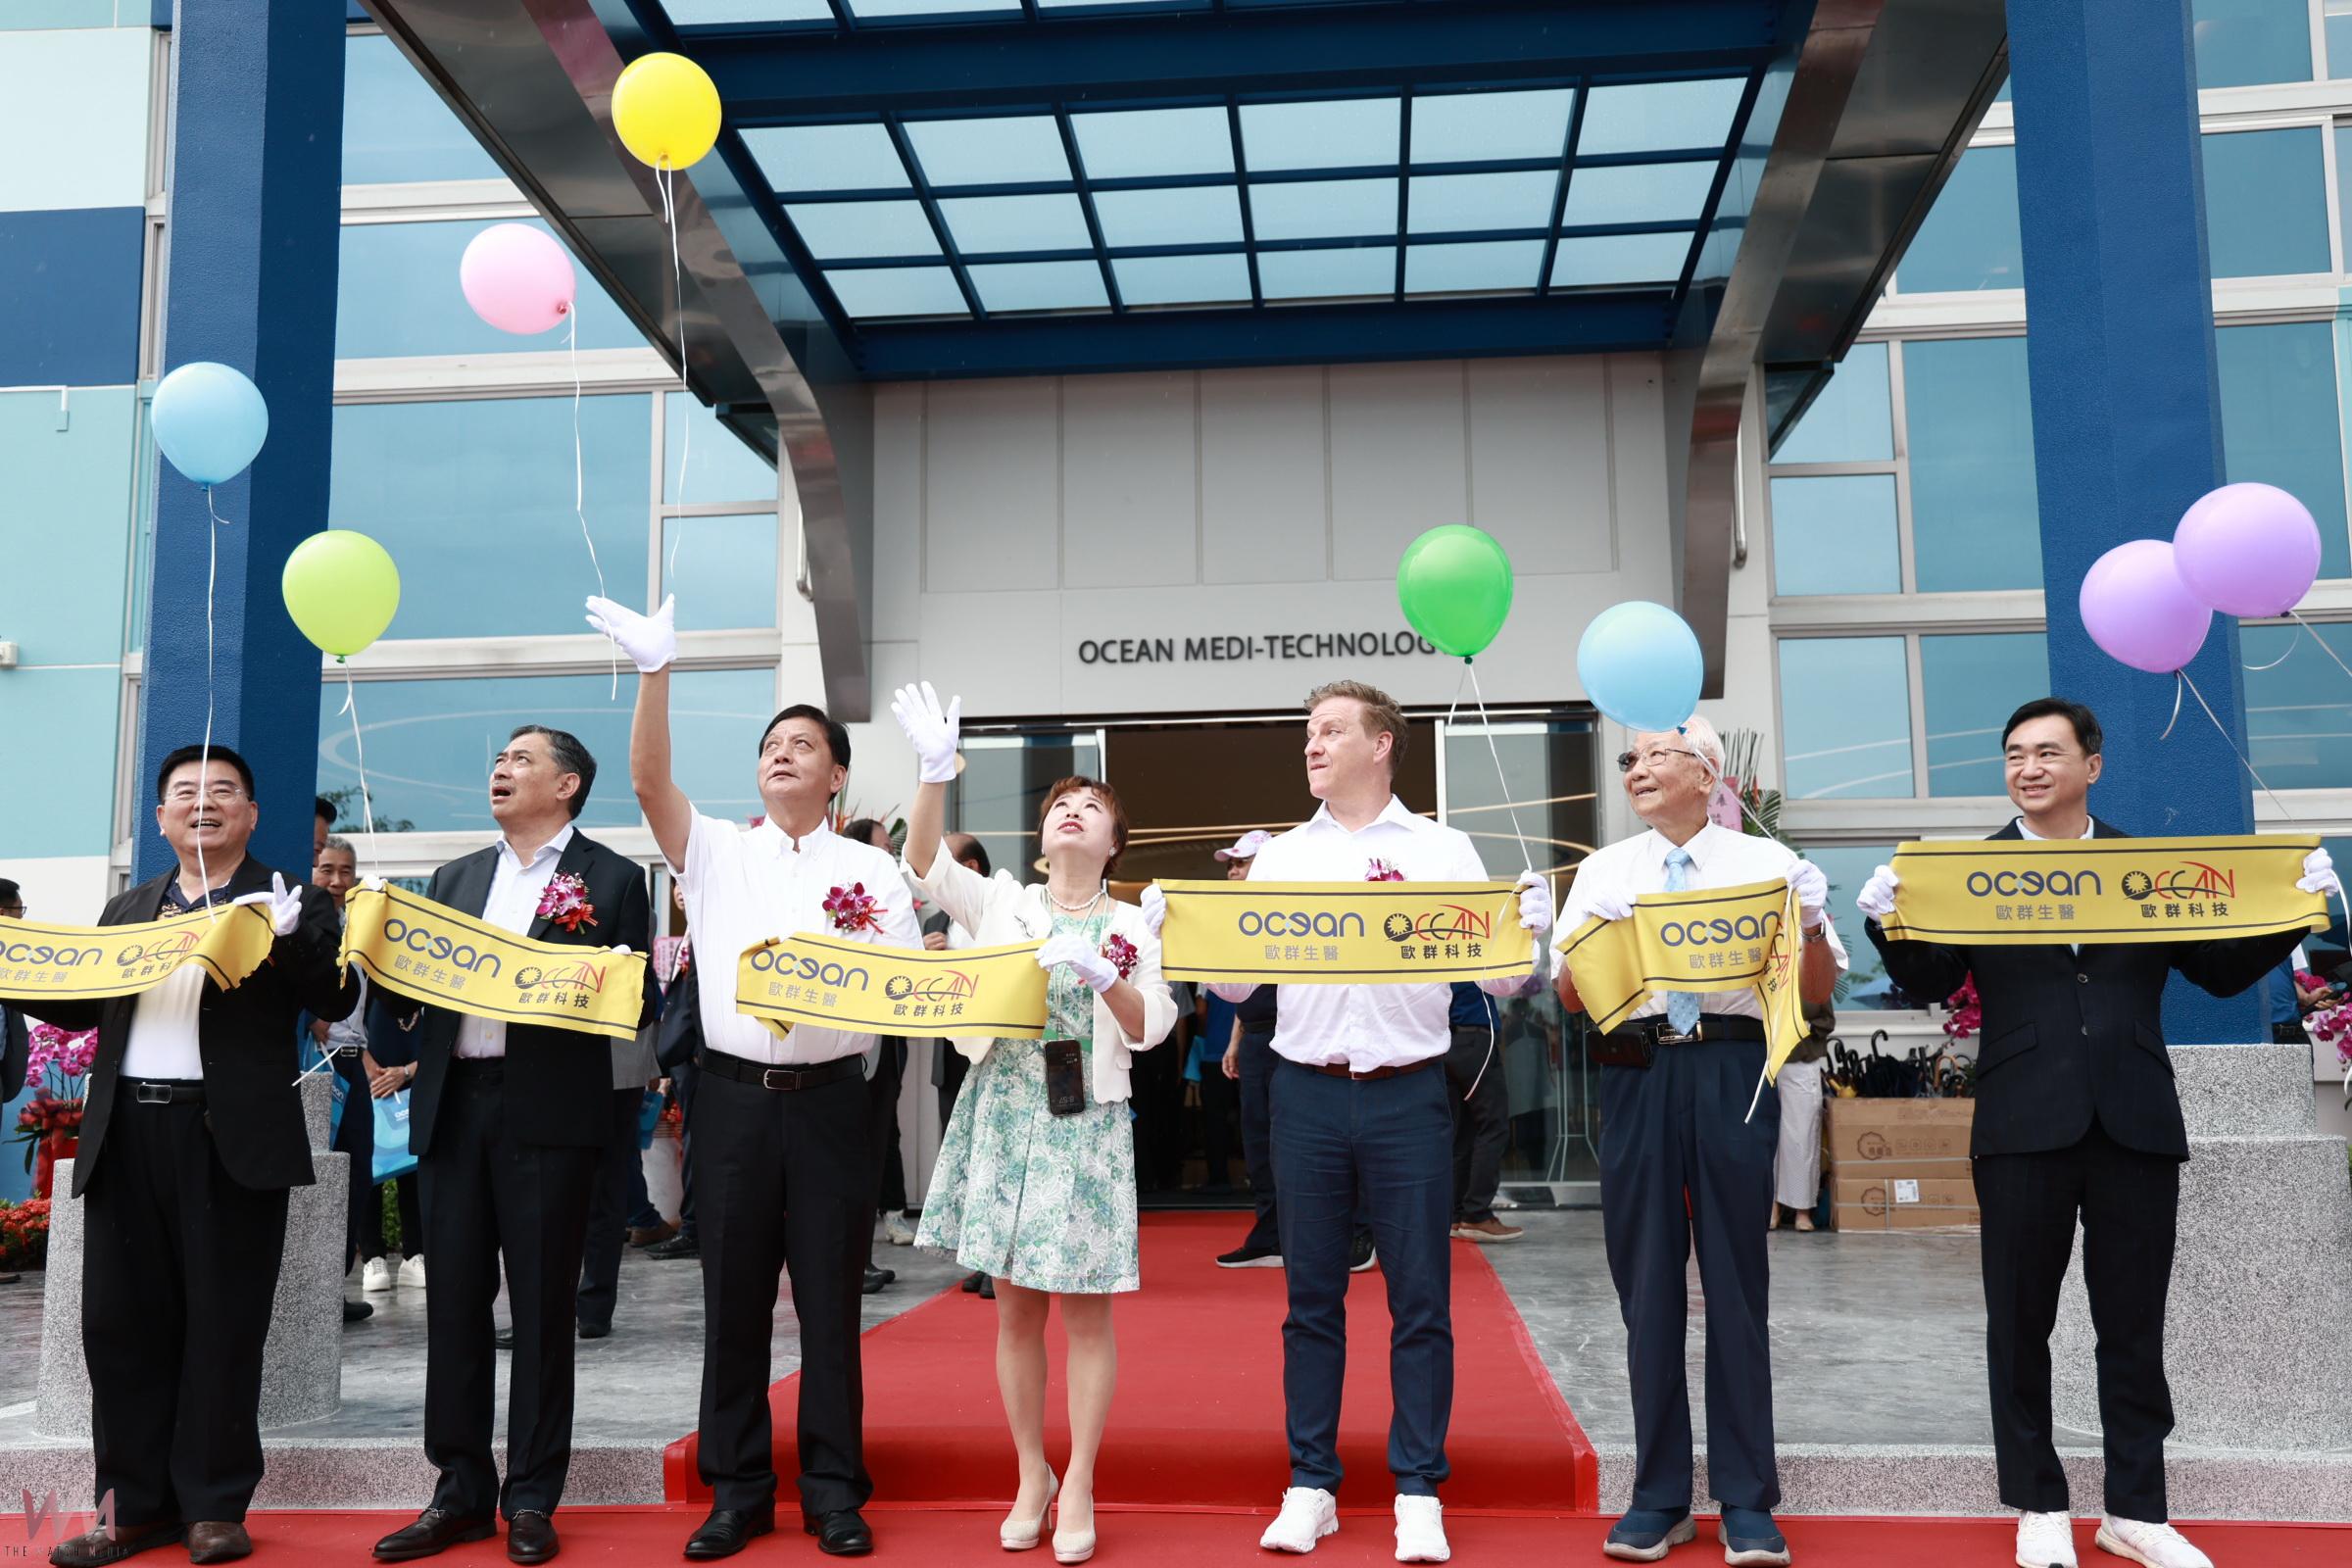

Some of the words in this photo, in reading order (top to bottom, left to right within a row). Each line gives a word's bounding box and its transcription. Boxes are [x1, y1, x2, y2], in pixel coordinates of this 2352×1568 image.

[1078, 638, 1174, 664] OCEAN
[1184, 630, 1446, 662] MEDI-TECHNOLOG
[1966, 869, 2102, 897] ocean
[1995, 904, 2075, 920] 歐群生醫
[2140, 902, 2230, 919] 歐群科技
[1238, 910, 1364, 938] ocean
[1660, 910, 1781, 948] ocean
[0, 940, 103, 966] cean
[383, 918, 502, 978] ocean
[1264, 944, 1339, 961] 歐群生醫
[1400, 942, 1483, 959] 歐群科技
[1689, 947, 1763, 970] 歐群生醫
[121, 956, 185, 979] 歐群科
[393, 954, 467, 990] 歐群生醫
[751, 949, 869, 992] ocean
[517, 991, 590, 1009] 歐群科技
[767, 980, 838, 1007] 歐群生醫
[893, 1003, 964, 1017] 歐群科技
